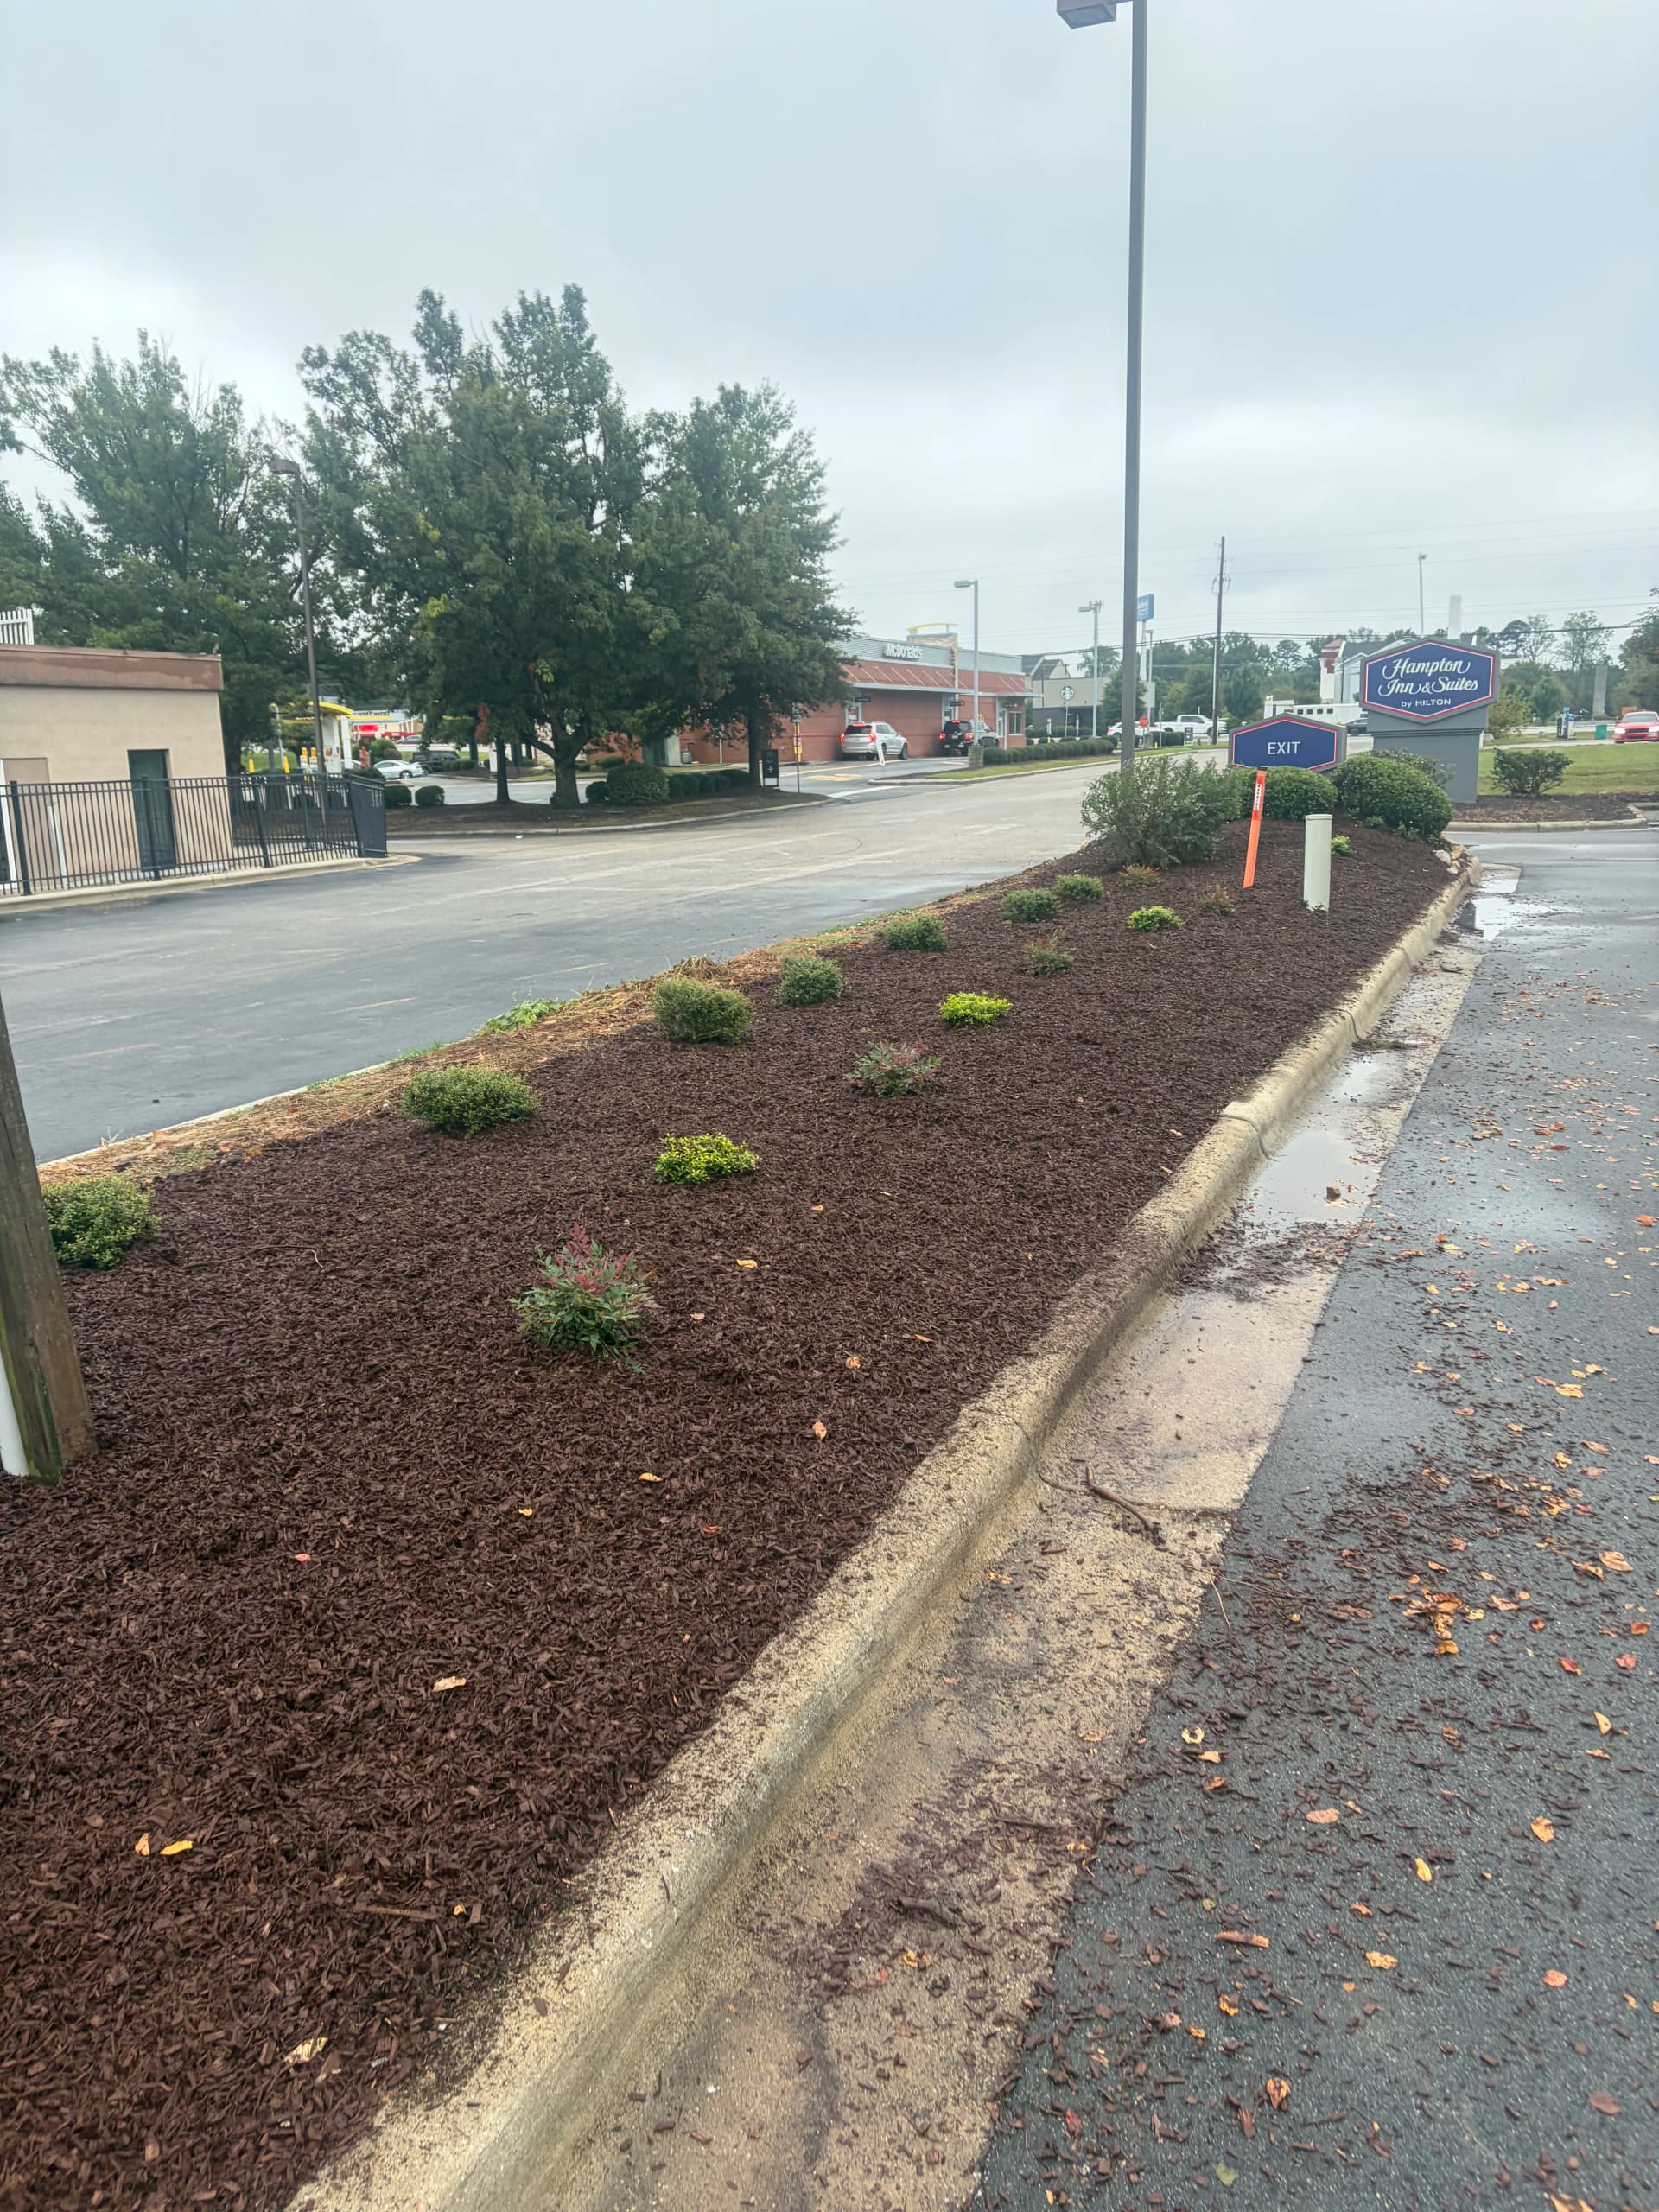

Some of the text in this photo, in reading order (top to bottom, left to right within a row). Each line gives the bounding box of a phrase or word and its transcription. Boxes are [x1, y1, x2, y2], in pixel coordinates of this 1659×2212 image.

[1382, 658, 1471, 680] Hampton
[1378, 677, 1478, 696] Inn & Suites
[1415, 698, 1452, 707] HILTON
[1268, 741, 1301, 754] EXIT
